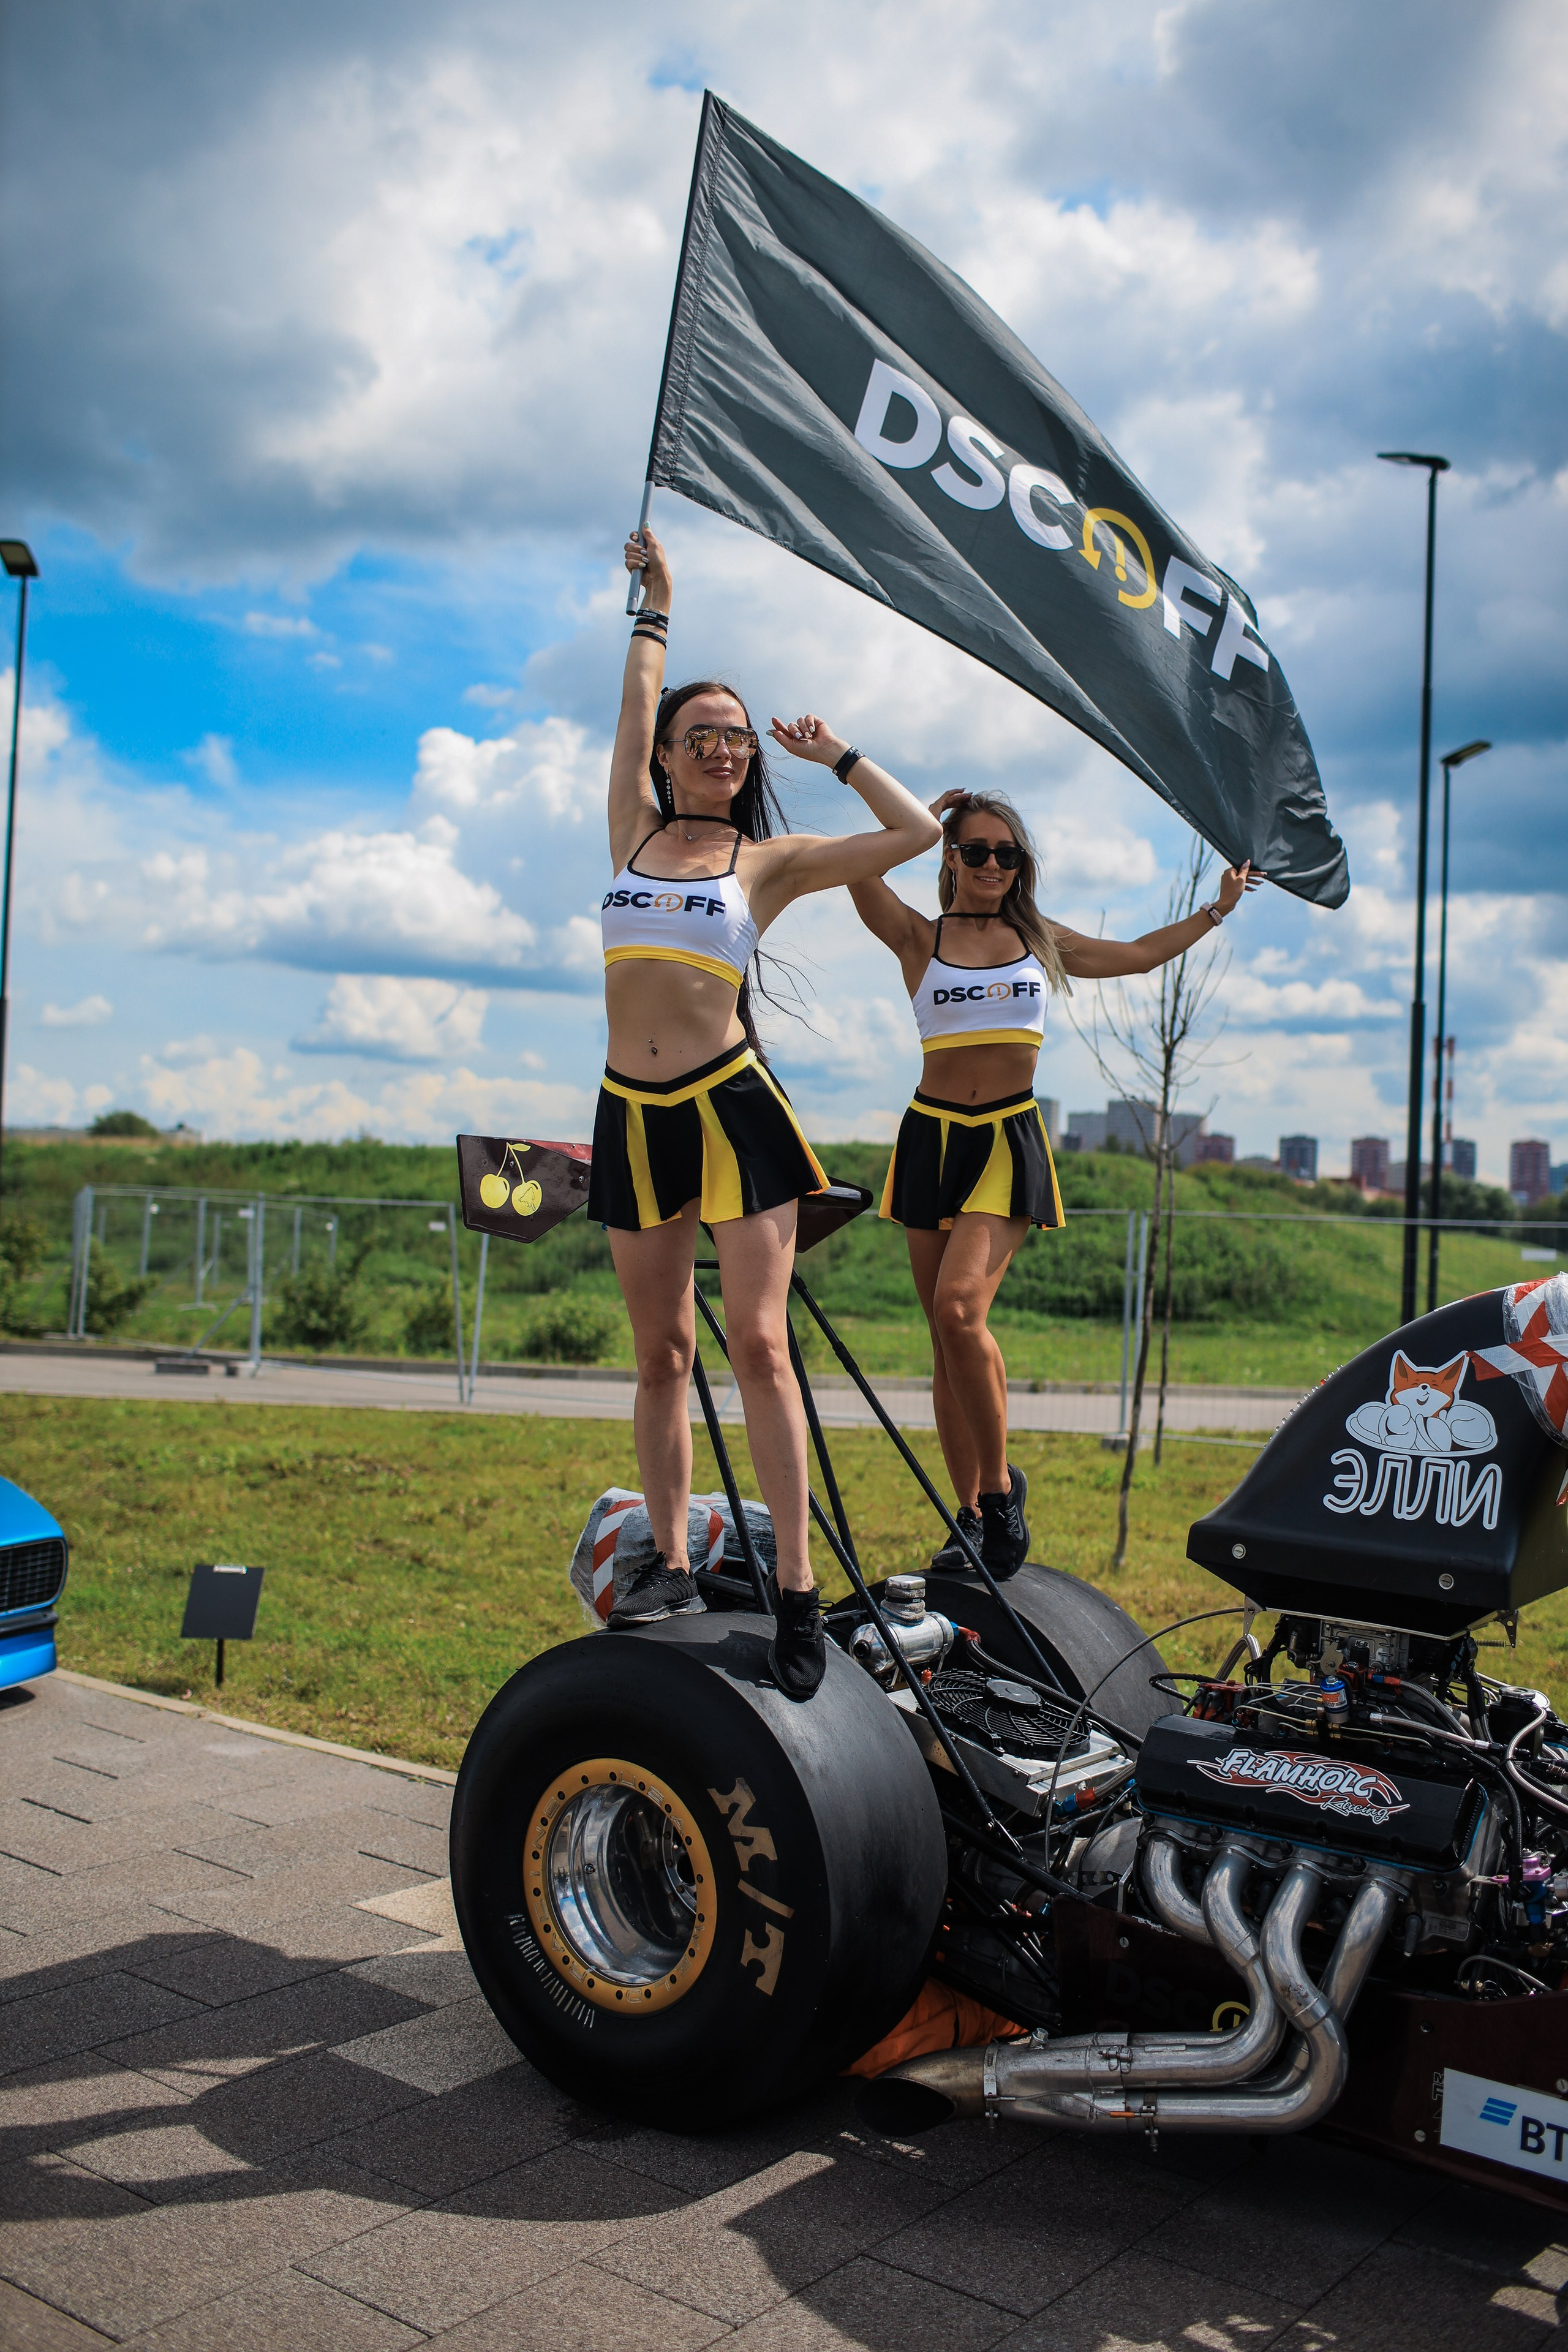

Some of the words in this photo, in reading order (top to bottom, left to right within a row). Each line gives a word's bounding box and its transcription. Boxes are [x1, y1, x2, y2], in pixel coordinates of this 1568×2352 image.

[933, 981, 1041, 1006] DSCOFF
[1322, 1448, 1503, 1531] ЭЛЛИ
[1219, 1749, 1379, 1799] FLAMHOLC
[1321, 1795, 1390, 1825] Racing
[707, 1777, 794, 1996] M/T
